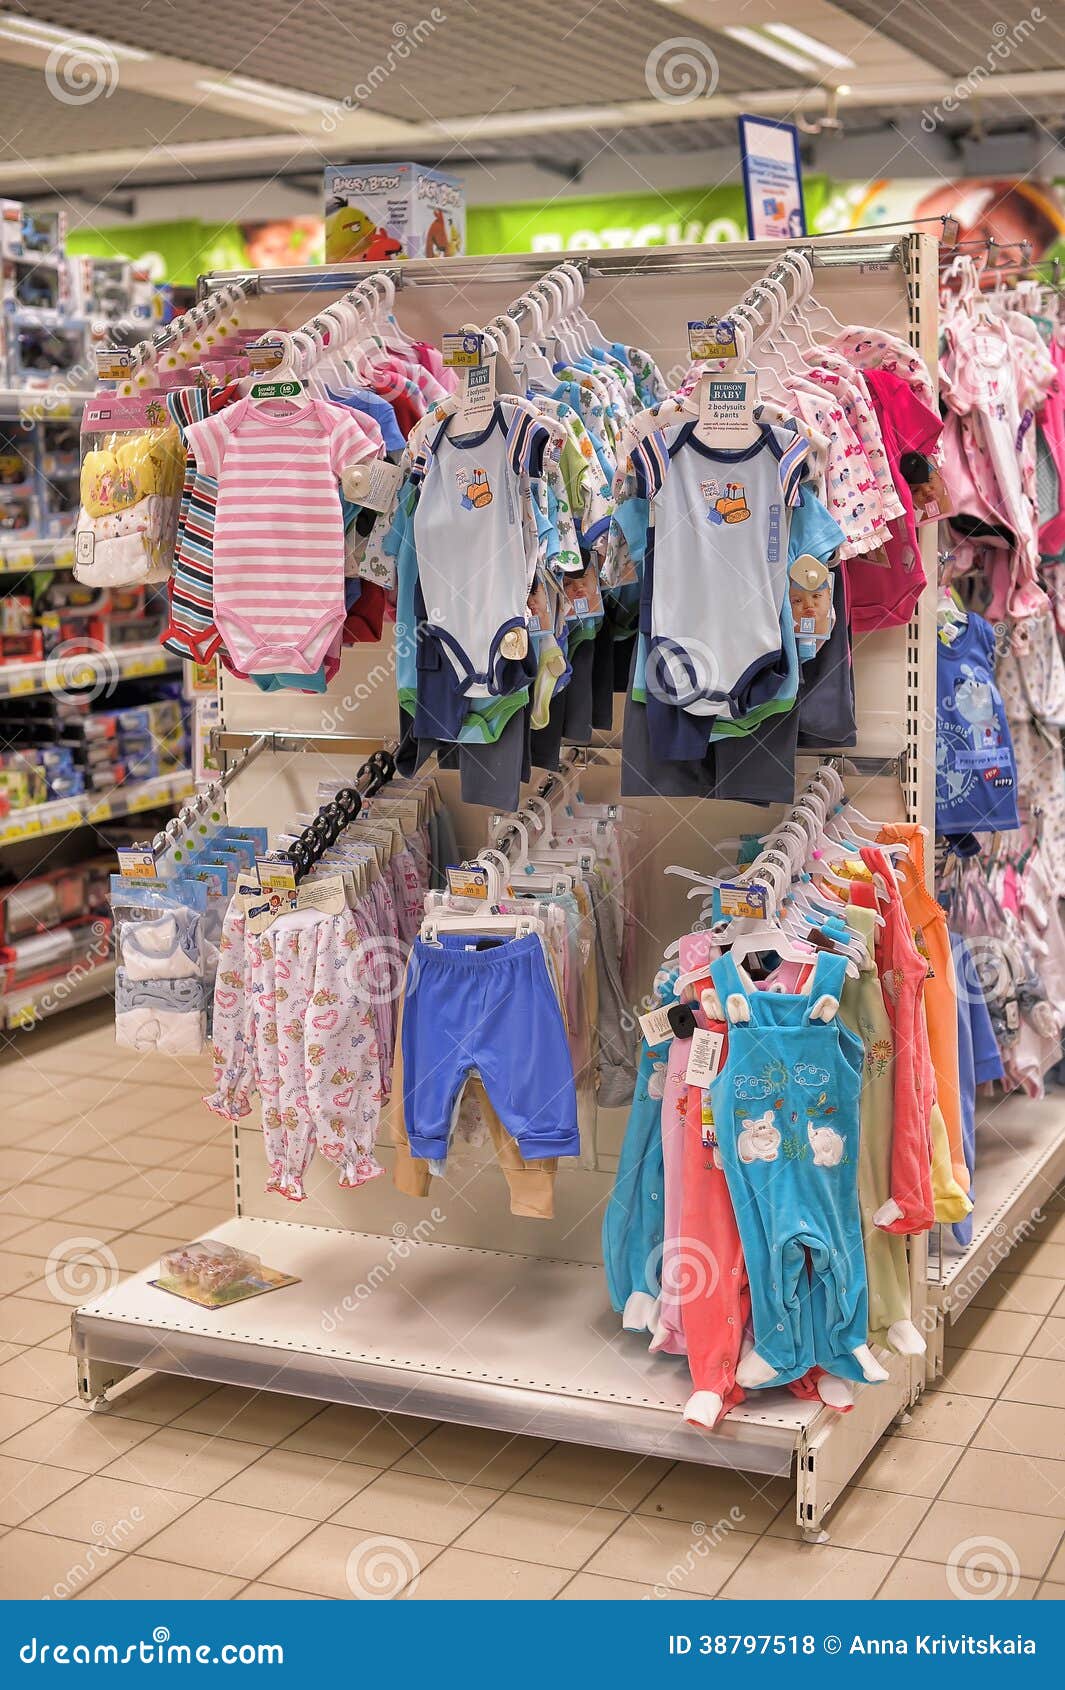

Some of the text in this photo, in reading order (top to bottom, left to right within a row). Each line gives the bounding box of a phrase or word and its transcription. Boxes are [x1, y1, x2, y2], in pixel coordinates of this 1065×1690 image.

[714, 390, 741, 399] BABY
[713, 403, 746, 412] bodysuits
[803, 621, 812, 630] M
